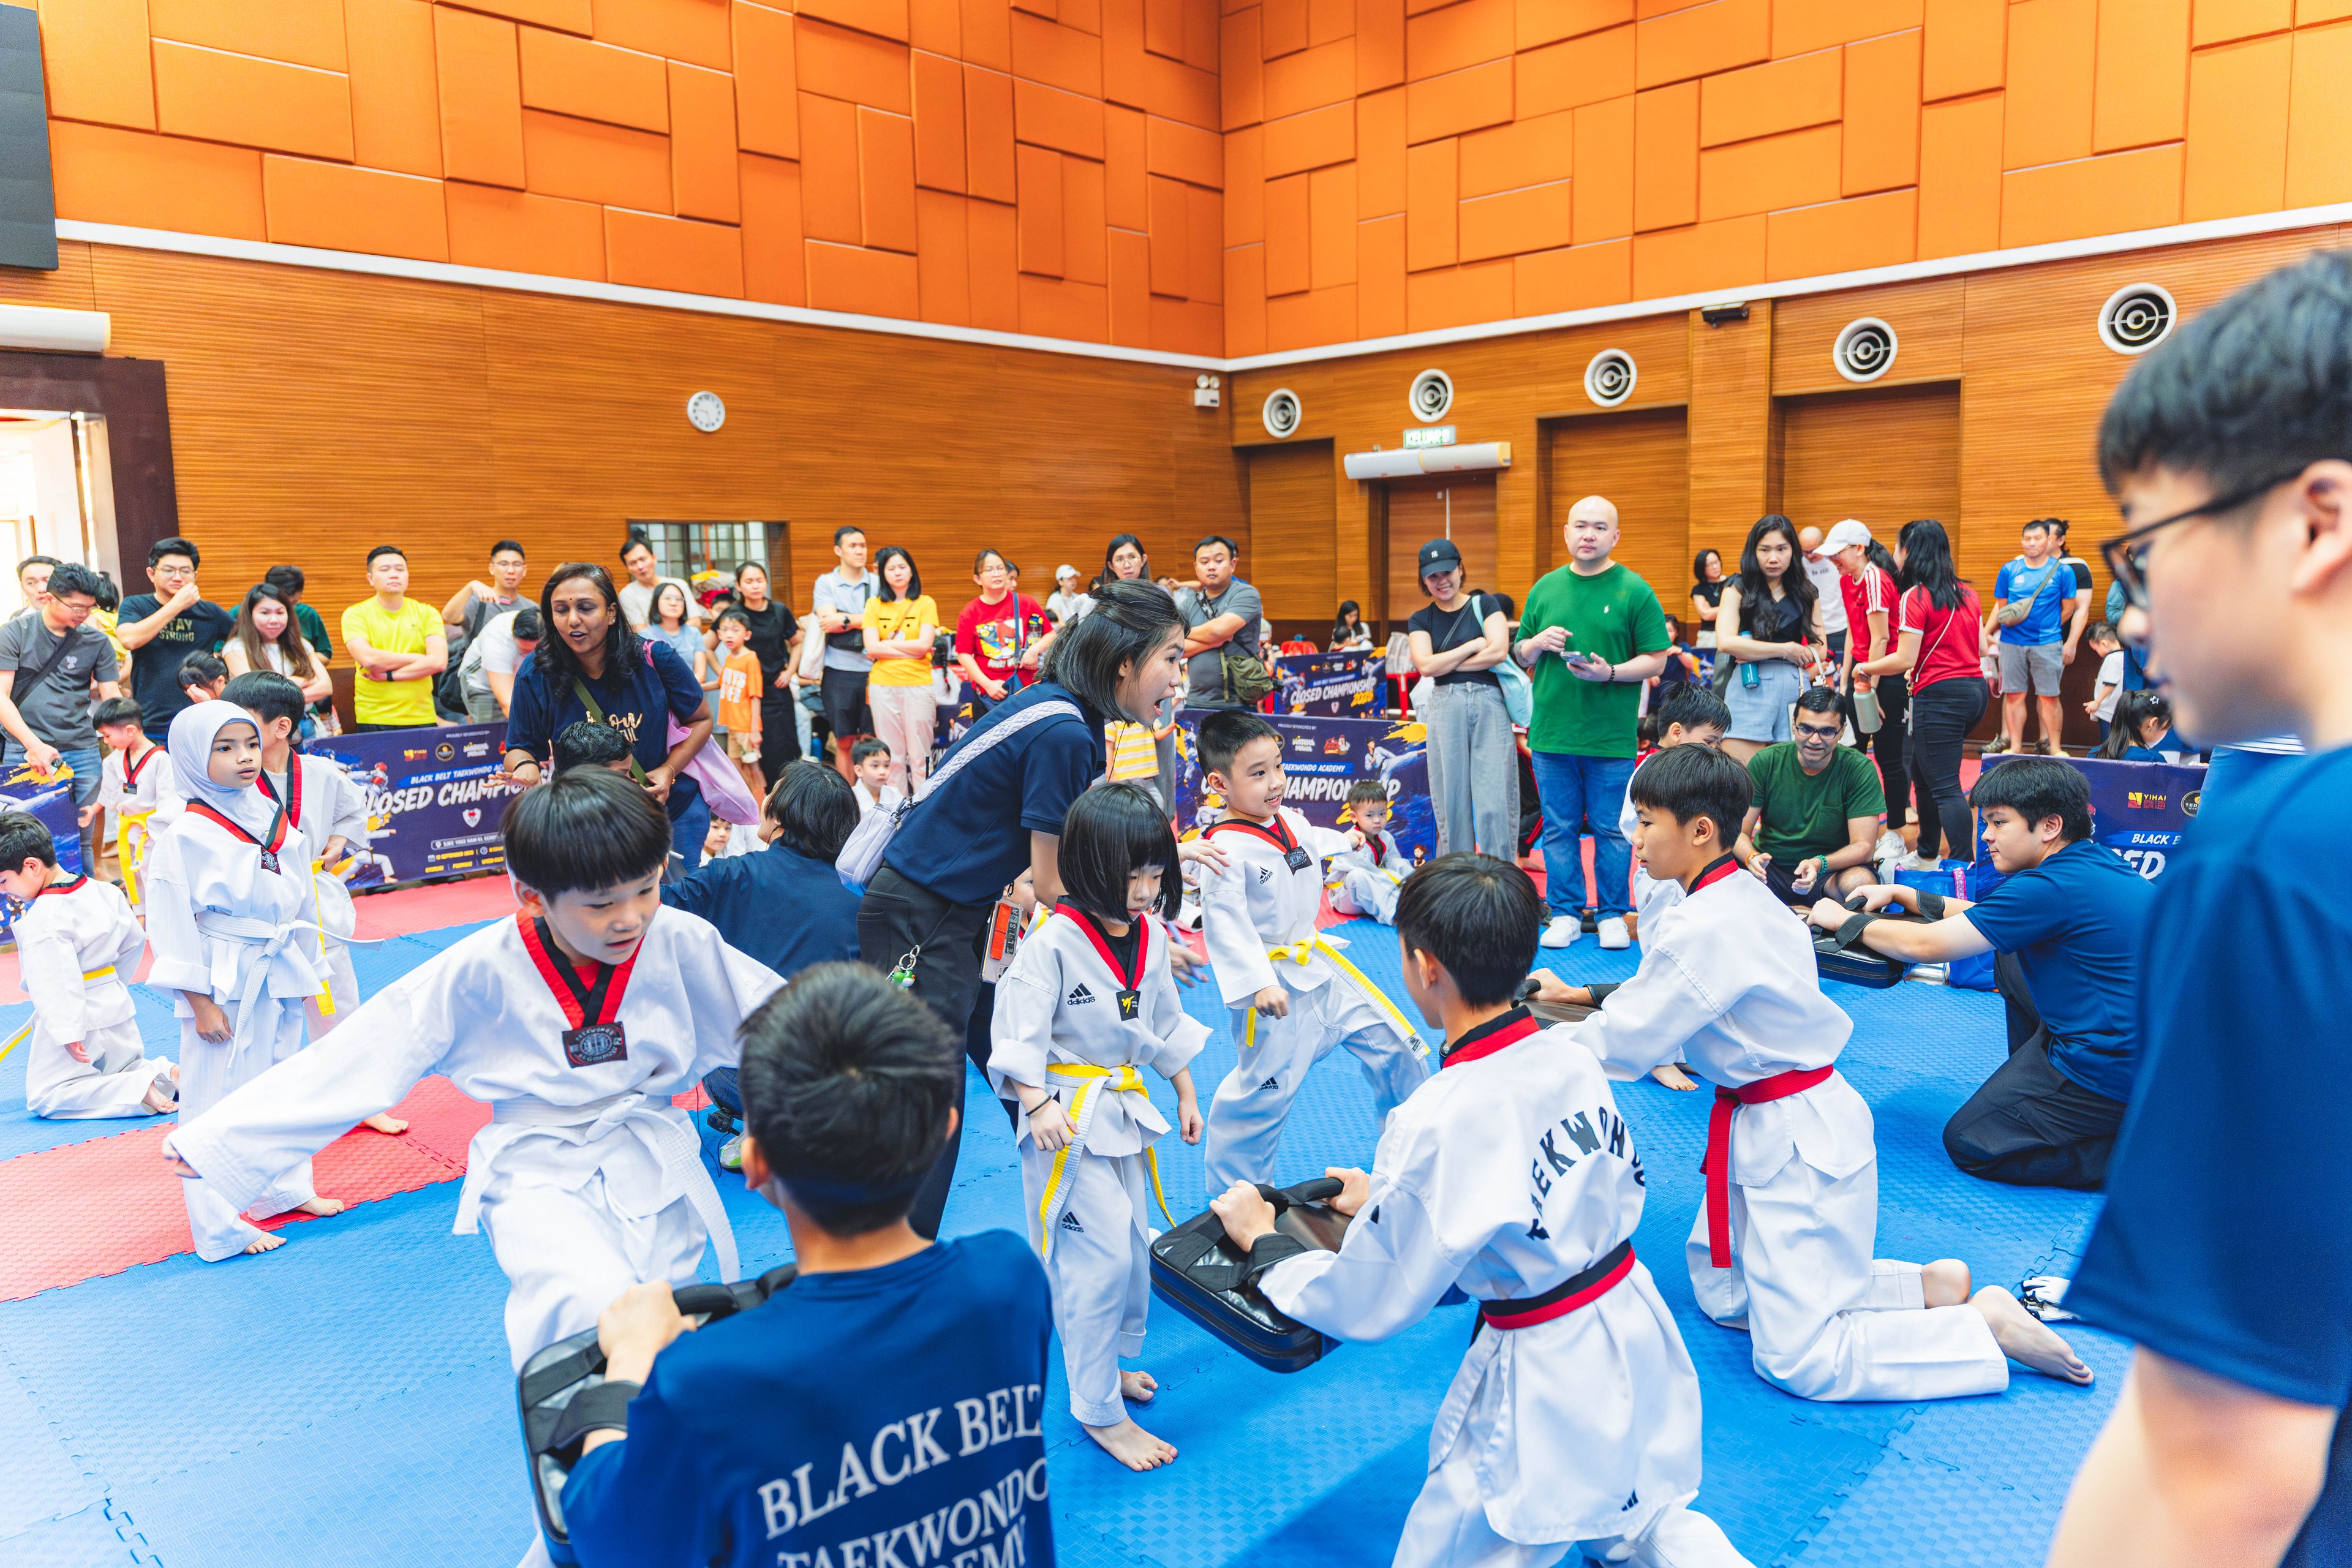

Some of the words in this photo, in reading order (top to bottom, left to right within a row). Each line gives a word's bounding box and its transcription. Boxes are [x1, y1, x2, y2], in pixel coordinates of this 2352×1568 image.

[164, 618, 192, 631] TAY
[1290, 687, 1322, 706] CLOSED
[1322, 676, 1377, 700] CHAMPIONSHIP
[1317, 764, 1346, 772] ACADEMY
[410, 774, 434, 785] BLACK
[434, 771, 452, 782] BELT
[365, 786, 434, 817] LOSED
[2132, 833, 2170, 845] BLACK
[1067, 996, 1096, 1005] adidas
[757, 1407, 951, 1540] BLACK
